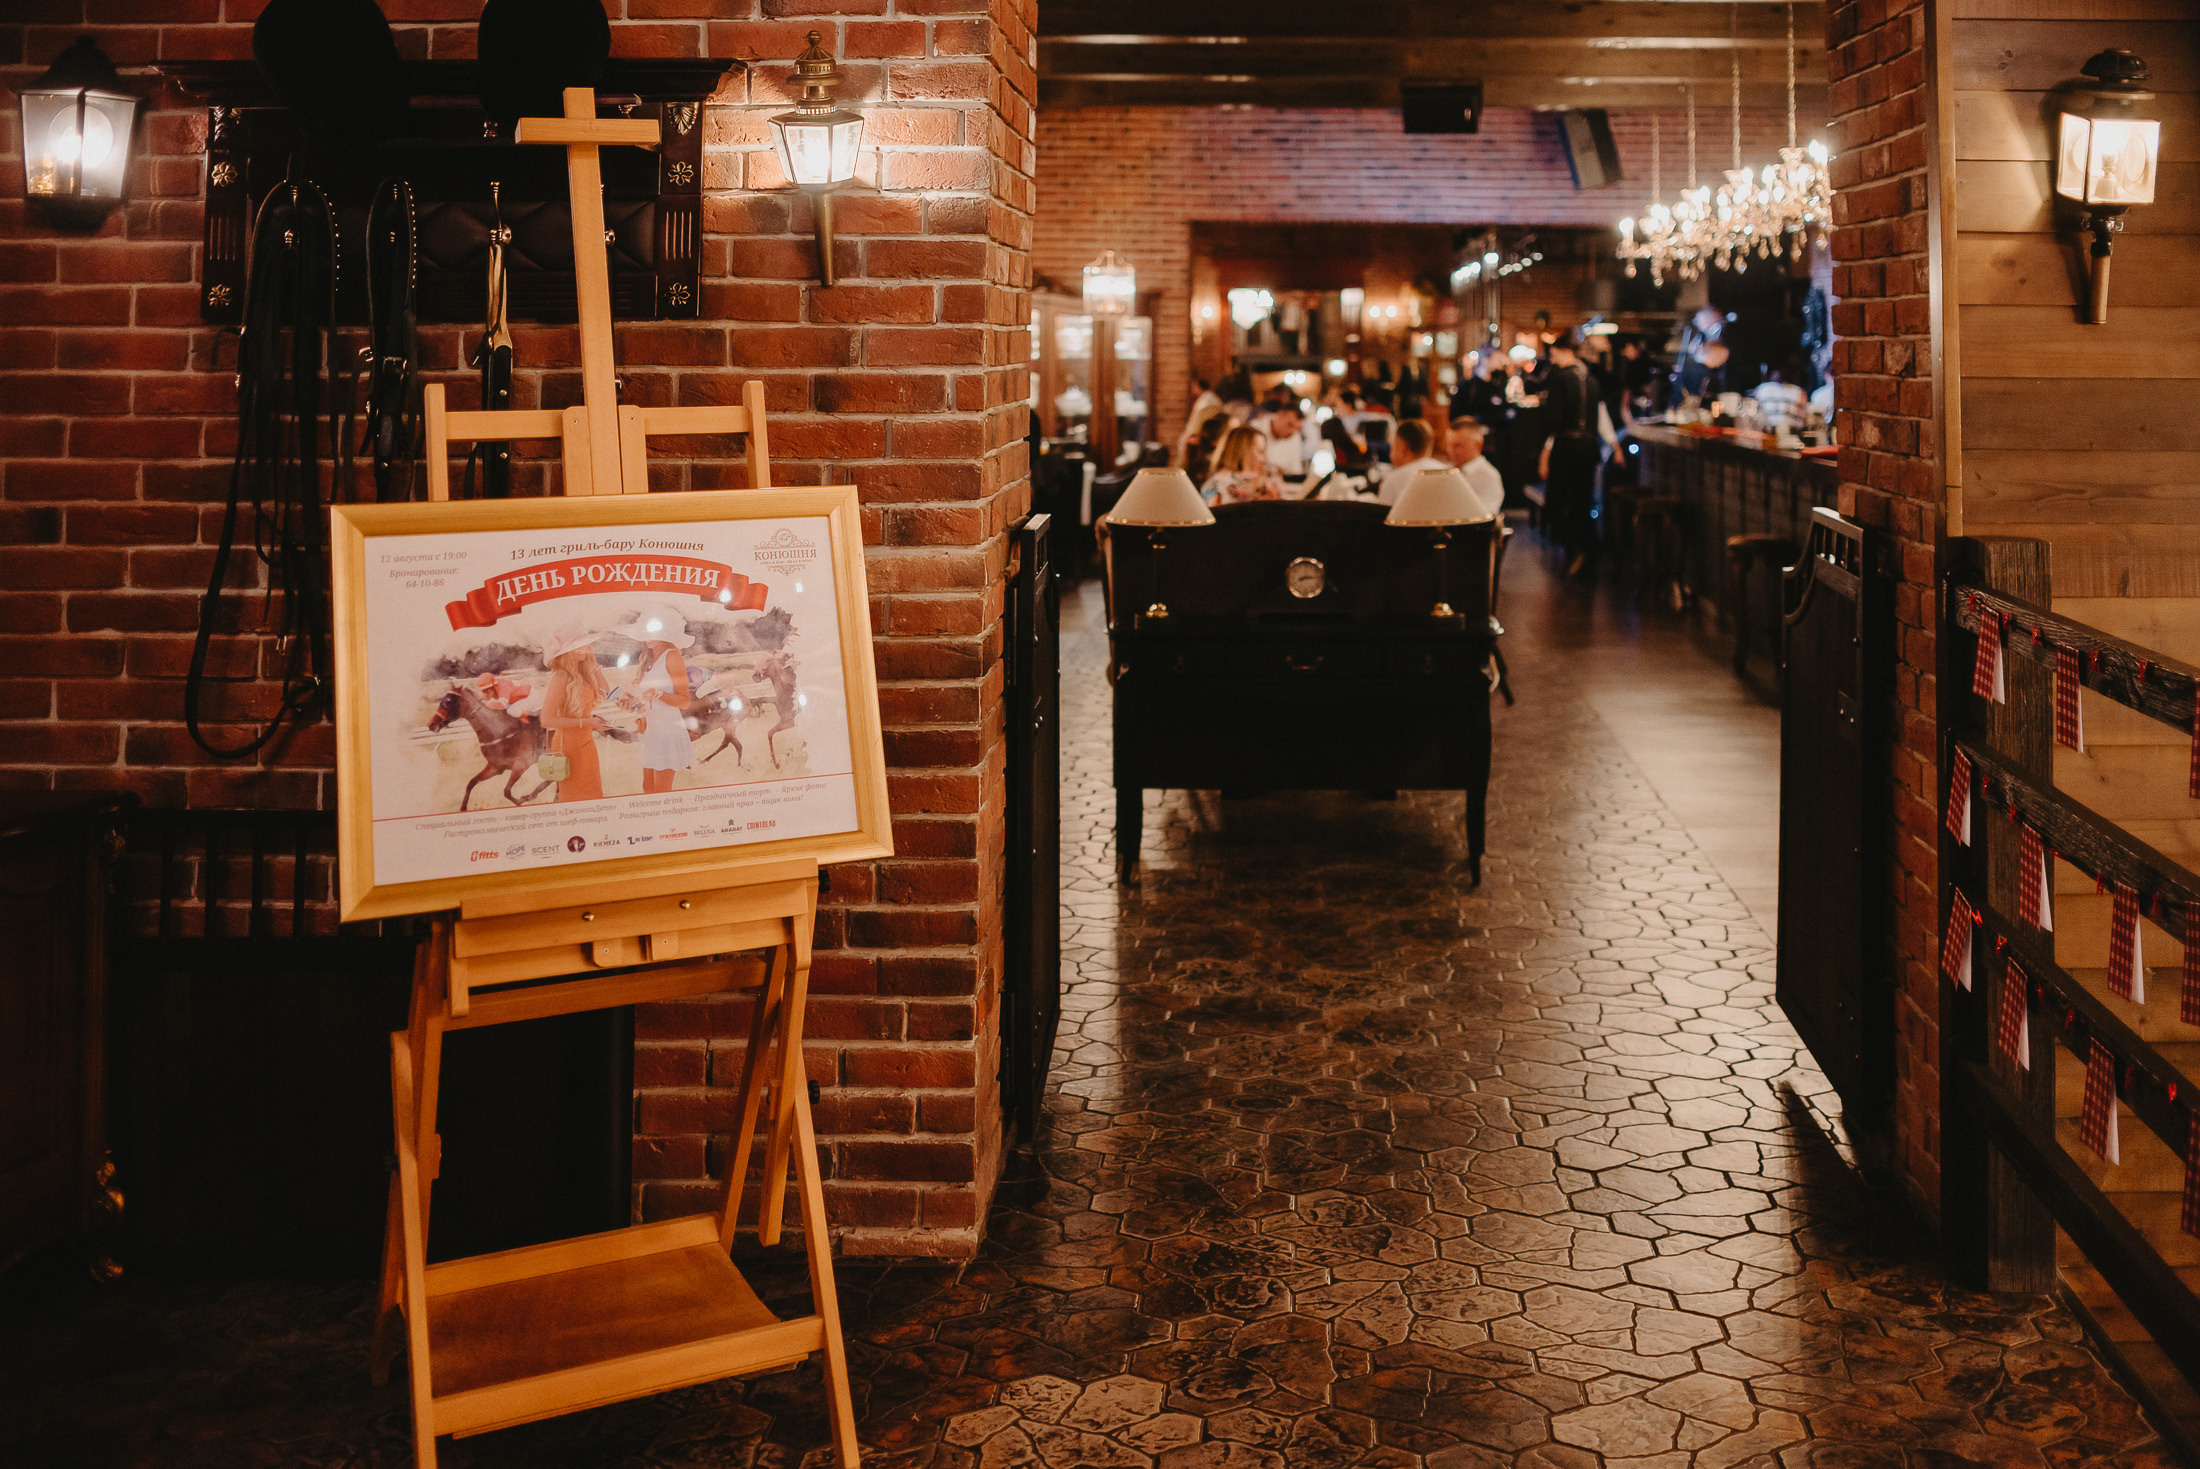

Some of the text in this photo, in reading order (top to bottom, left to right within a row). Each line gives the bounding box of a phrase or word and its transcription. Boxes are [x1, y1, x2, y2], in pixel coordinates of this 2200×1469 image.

[510, 538, 704, 560] 13 лет гриль-бару Конюшня
[754, 549, 817, 561] КОНЮШНЯ
[380, 555, 391, 563] 12
[393, 554, 433, 564] августа
[443, 551, 467, 560] 19:00
[389, 568, 460, 579] Бронирование:
[405, 579, 445, 588] 64-10-86
[496, 563, 720, 606] ДЕНЬ РОЖДЕНИЯ
[415, 818, 471, 830] Специальный
[472, 816, 497, 825] гость
[505, 811, 557, 821] кавер-группа
[628, 797, 662, 808] Welcome
[663, 796, 683, 805] drink
[694, 790, 747, 802] Праздничный
[748, 789, 771, 797] торт
[781, 784, 803, 793] Яркие
[805, 783, 827, 792] фото
[444, 823, 526, 838] Гастрономический
[528, 821, 544, 829] сет
[560, 815, 608, 826] шеф-повара
[619, 810, 660, 820] Розыгрыш
[702, 802, 735, 811] главный
[736, 800, 754, 809] приз
[783, 794, 804, 802] вина!
[479, 850, 499, 860] fitts
[531, 845, 560, 855] SCENT
